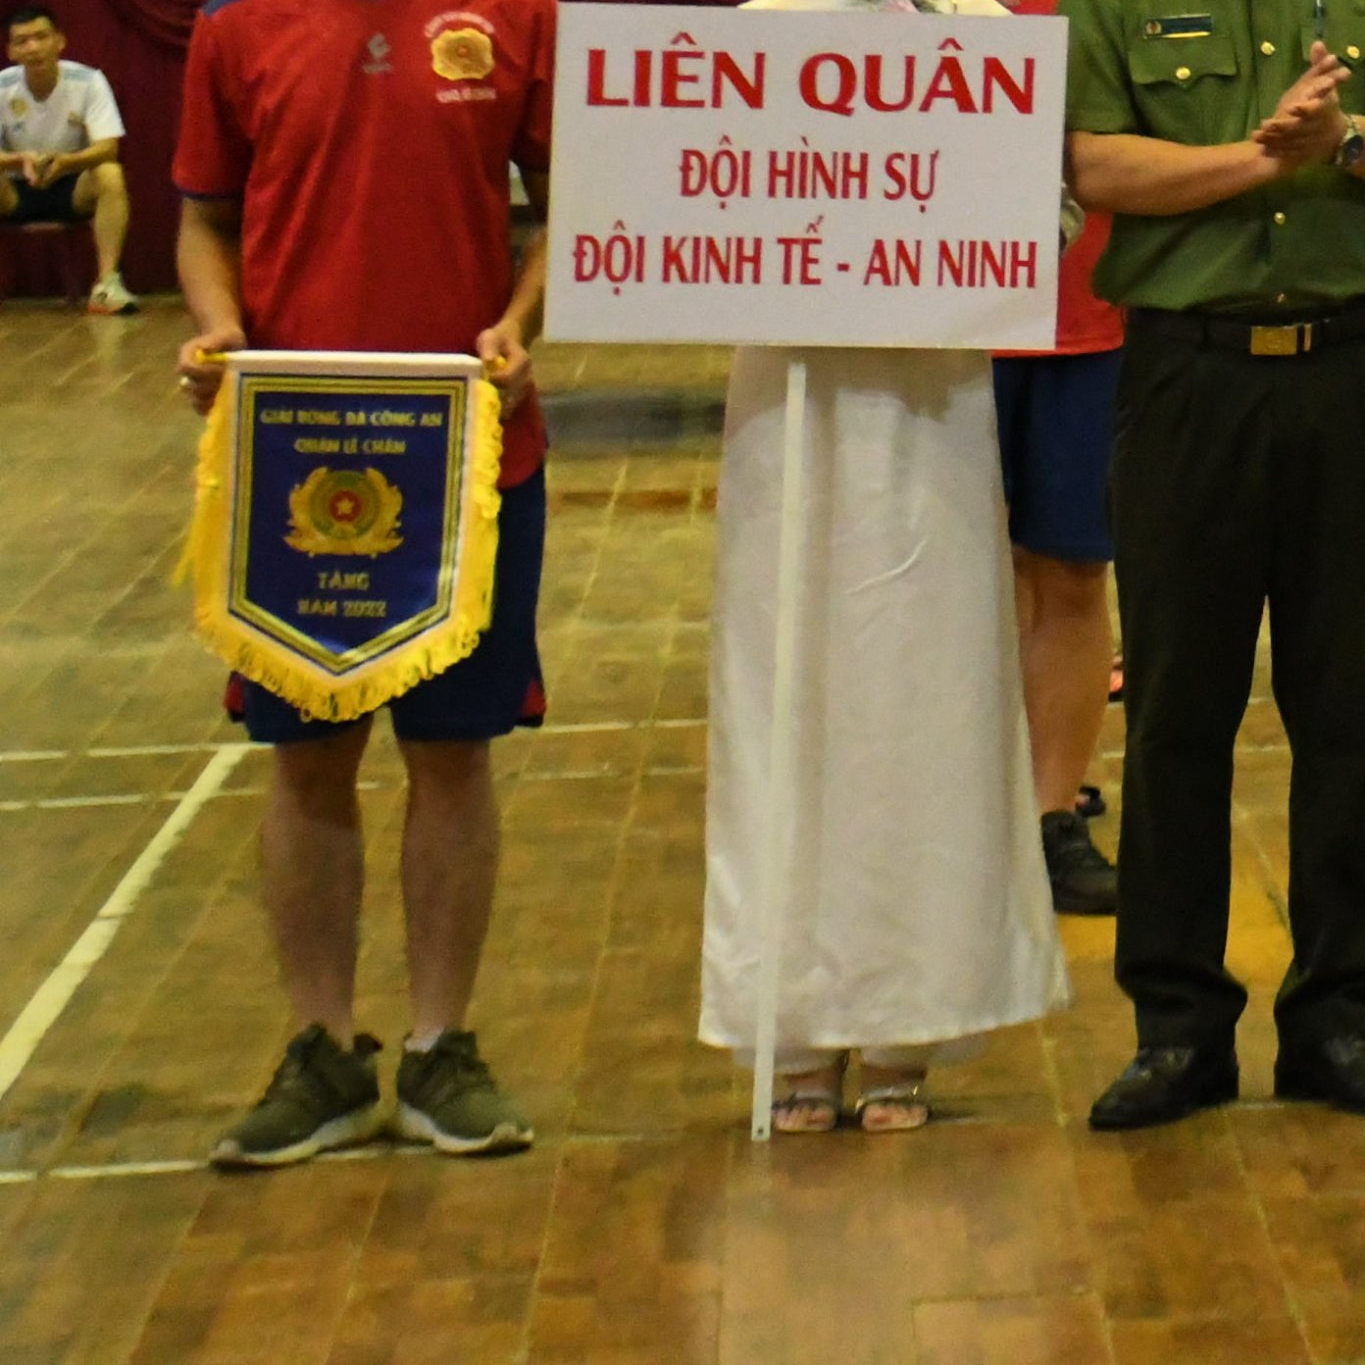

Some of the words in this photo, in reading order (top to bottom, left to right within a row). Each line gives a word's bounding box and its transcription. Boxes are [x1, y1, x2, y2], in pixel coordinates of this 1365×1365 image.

[586, 32, 766, 110] LIÊN
[798, 37, 1036, 117] QUÂN
[679, 135, 751, 210] ĐỘI
[767, 136, 869, 200] HÌNH
[883, 149, 940, 214] SỰ
[572, 220, 646, 296] ĐỘI
[662, 235, 762, 286] KINH
[777, 215, 823, 286] TẾ
[863, 238, 922, 288] AN
[937, 239, 1038, 289] NINH
